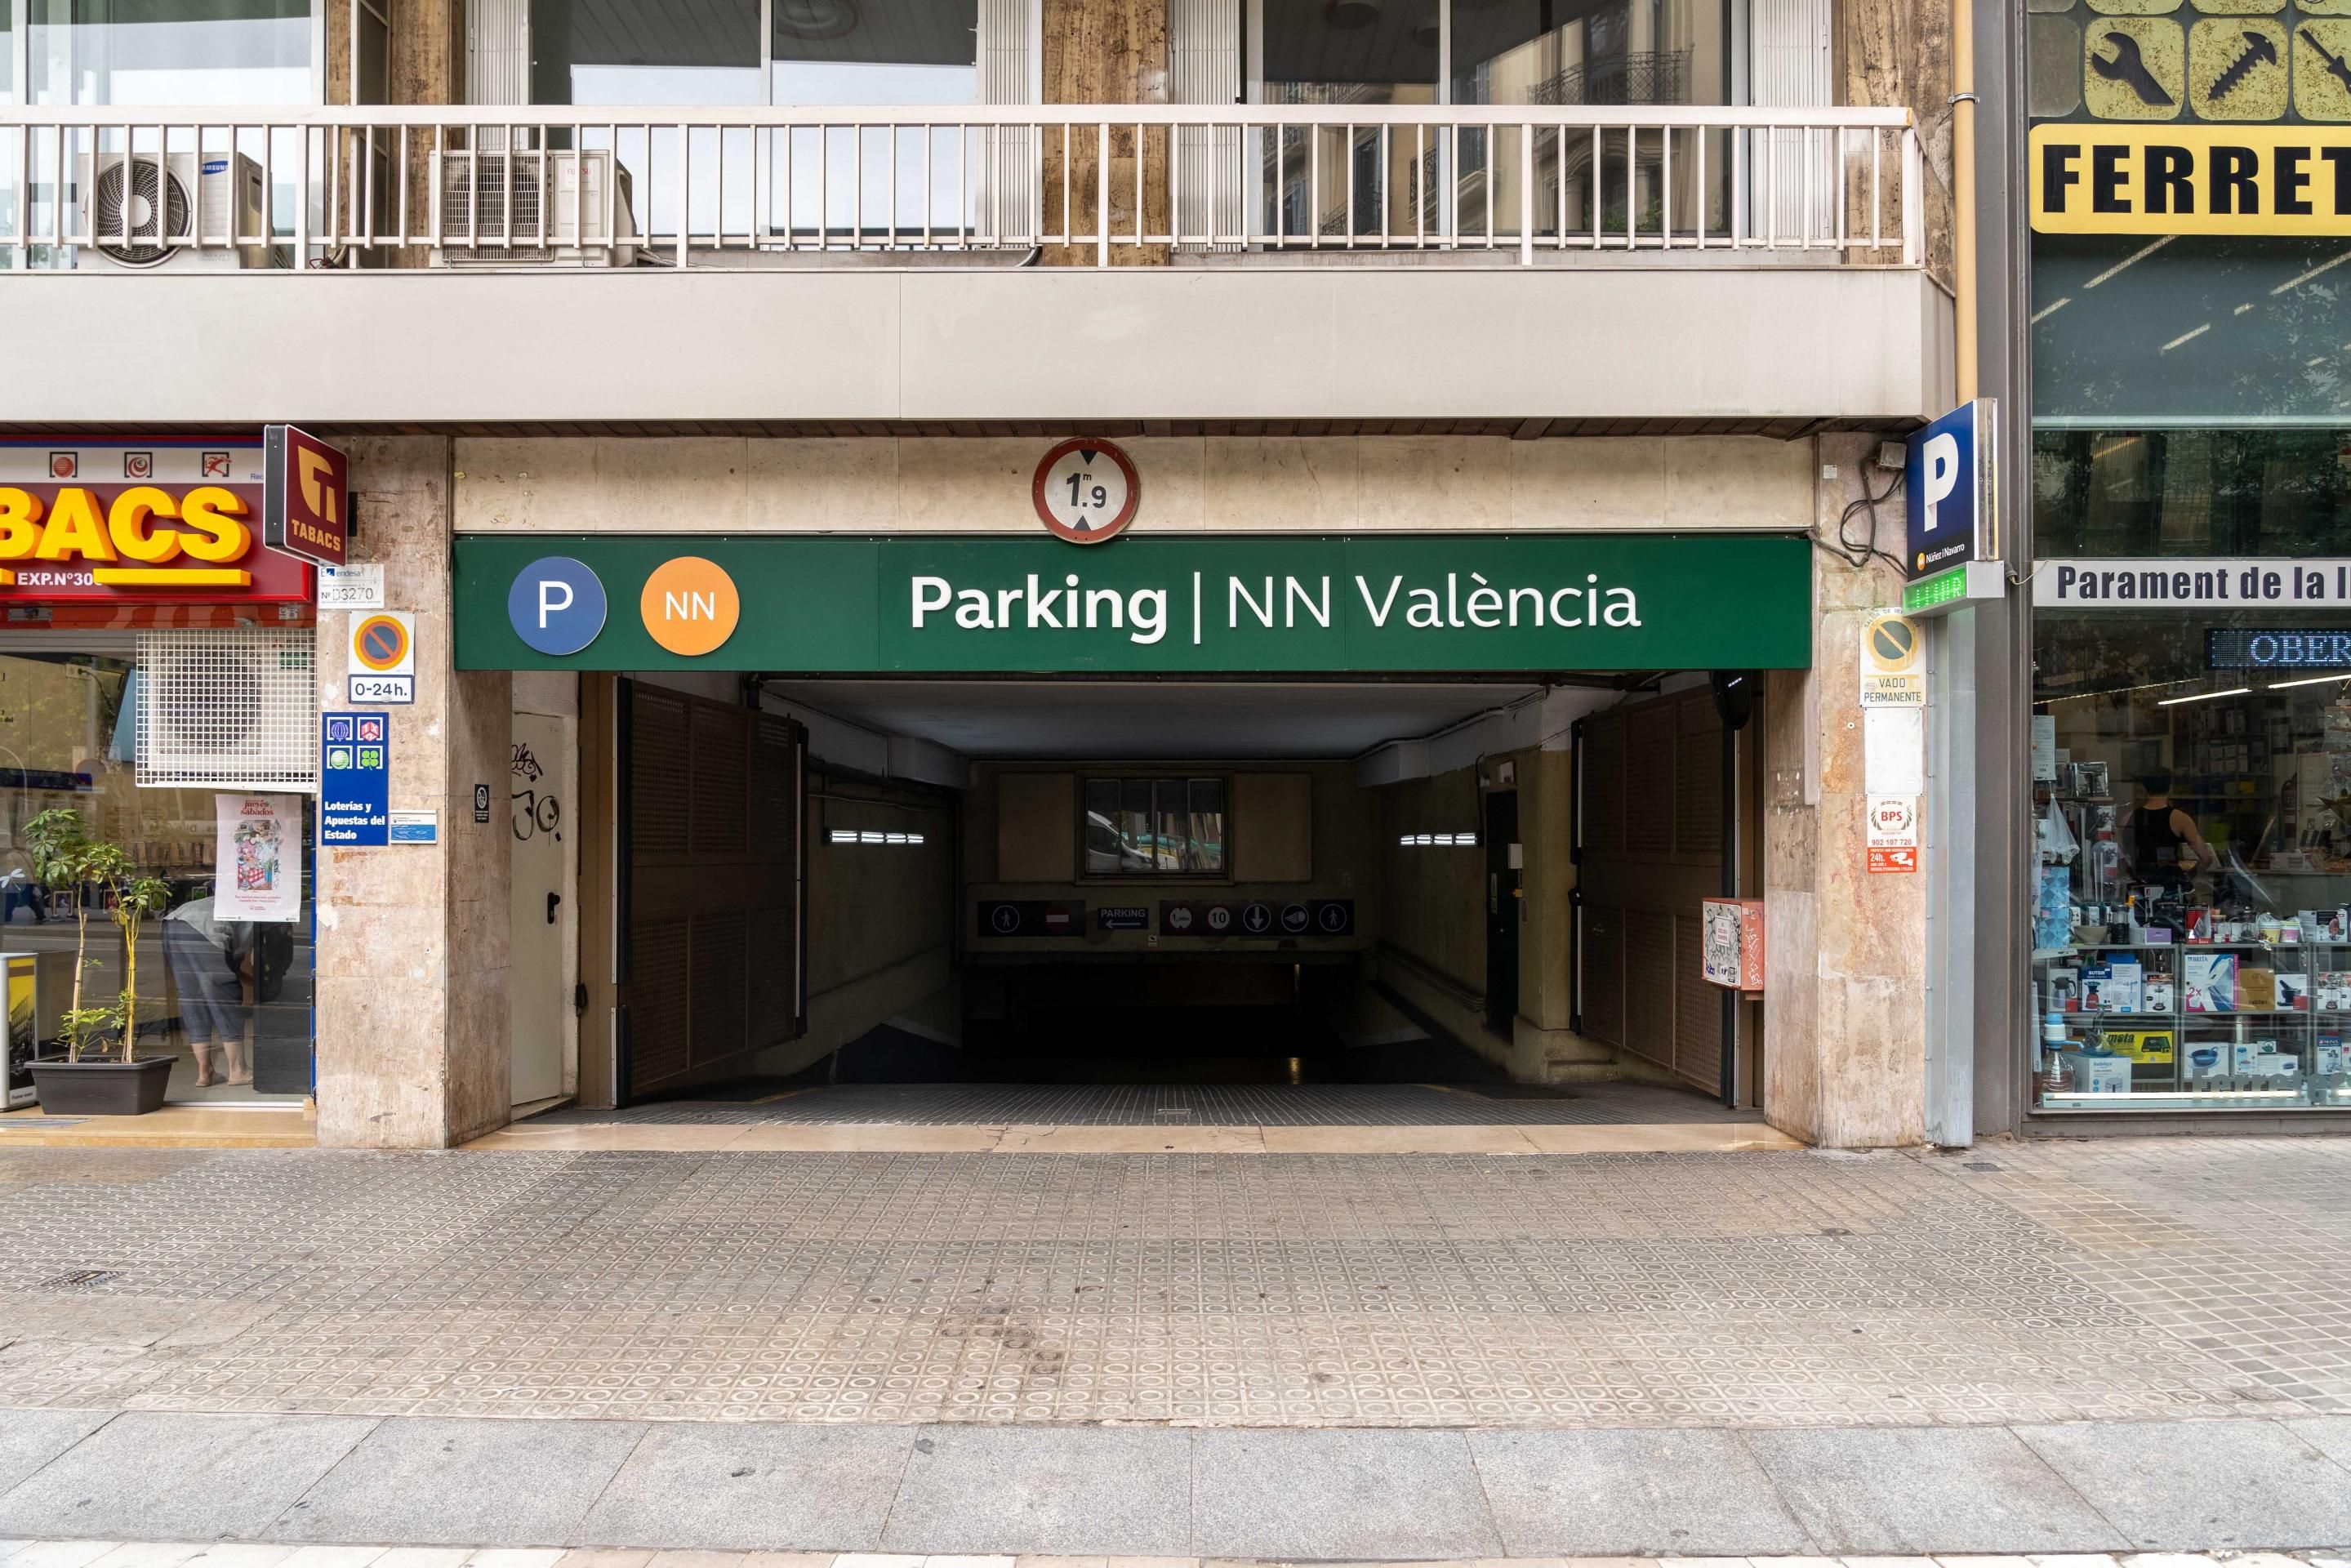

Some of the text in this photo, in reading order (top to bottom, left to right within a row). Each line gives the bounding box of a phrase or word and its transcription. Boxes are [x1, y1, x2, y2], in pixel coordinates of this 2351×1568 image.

[2042, 144, 2351, 216] FERRET
[1922, 432, 1959, 532] P
[291, 518, 341, 553] TABACS
[1926, 550, 1942, 564] Núñez
[1944, 542, 1965, 556] Navarro
[17, 572, 104, 586] EXP.Nº30
[336, 569, 361, 577] endesa
[2057, 566, 2229, 599] Parament
[2240, 567, 2281, 599] de
[2294, 567, 2325, 599] la
[538, 580, 573, 629] P
[666, 591, 715, 621] NN
[911, 572, 1642, 644] Parking NN València
[2250, 635, 2351, 662] OBER
[1879, 678, 1906, 688] VADO
[1864, 692, 1921, 702] PERMANENTE
[324, 801, 372, 813] Loterías y
[324, 815, 368, 827] Apuestas
[370, 815, 385, 826] del
[1881, 811, 1903, 822] BPS
[324, 830, 357, 840] Estado
[1101, 909, 1146, 918] PARKING
[1212, 912, 1226, 924] 10
[2188, 987, 2202, 996] 2x
